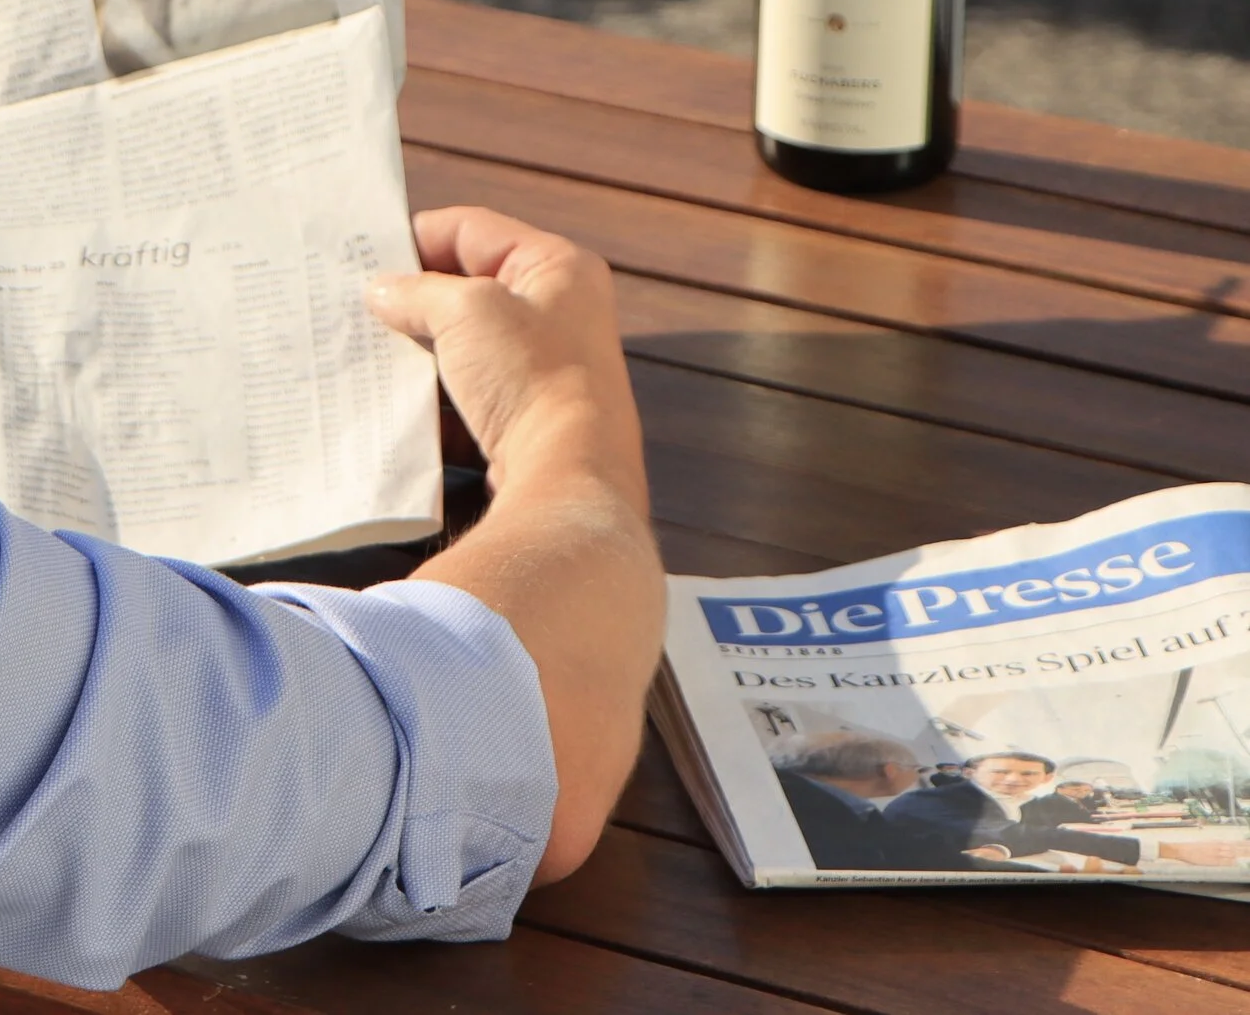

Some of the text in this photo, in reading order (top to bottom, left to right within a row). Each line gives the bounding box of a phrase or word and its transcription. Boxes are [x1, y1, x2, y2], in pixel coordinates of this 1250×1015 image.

[78, 236, 192, 268] kräftig
[724, 539, 1197, 637] Die Presse
[719, 643, 844, 657] SEIT 1848
[732, 669, 816, 690] Des
[829, 659, 1027, 688] Kanzlers
[1038, 636, 1150, 674] Spiel
[1161, 614, 1231, 652] auf
